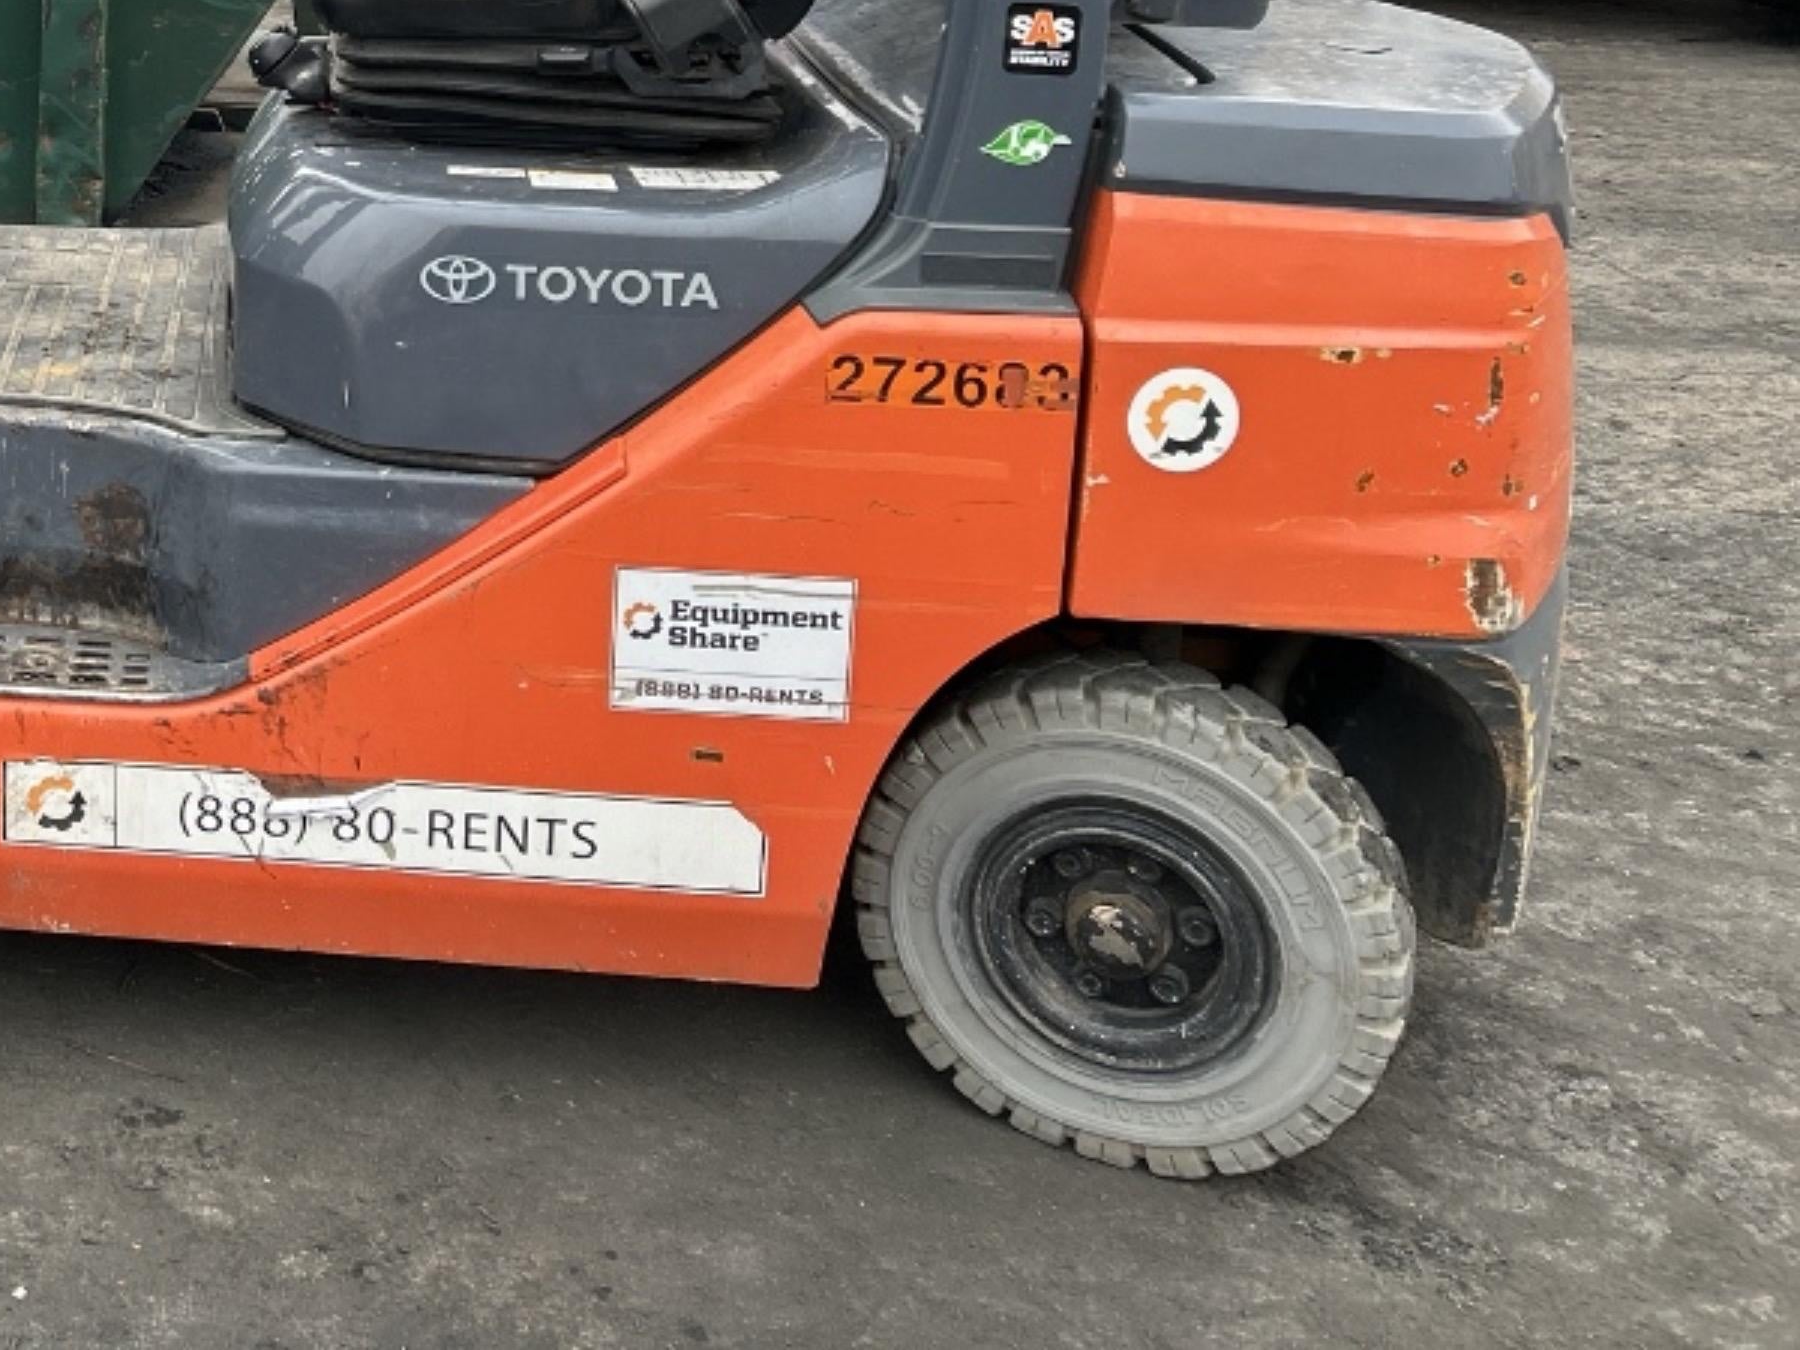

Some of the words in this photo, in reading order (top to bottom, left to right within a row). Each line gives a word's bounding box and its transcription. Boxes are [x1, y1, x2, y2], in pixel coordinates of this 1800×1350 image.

[1009, 8, 1075, 48] SAS
[505, 262, 720, 310] TOYOTA
[670, 599, 844, 630] Equipment
[667, 626, 760, 652] Share
[332, 800, 599, 860] 80-RENTS
